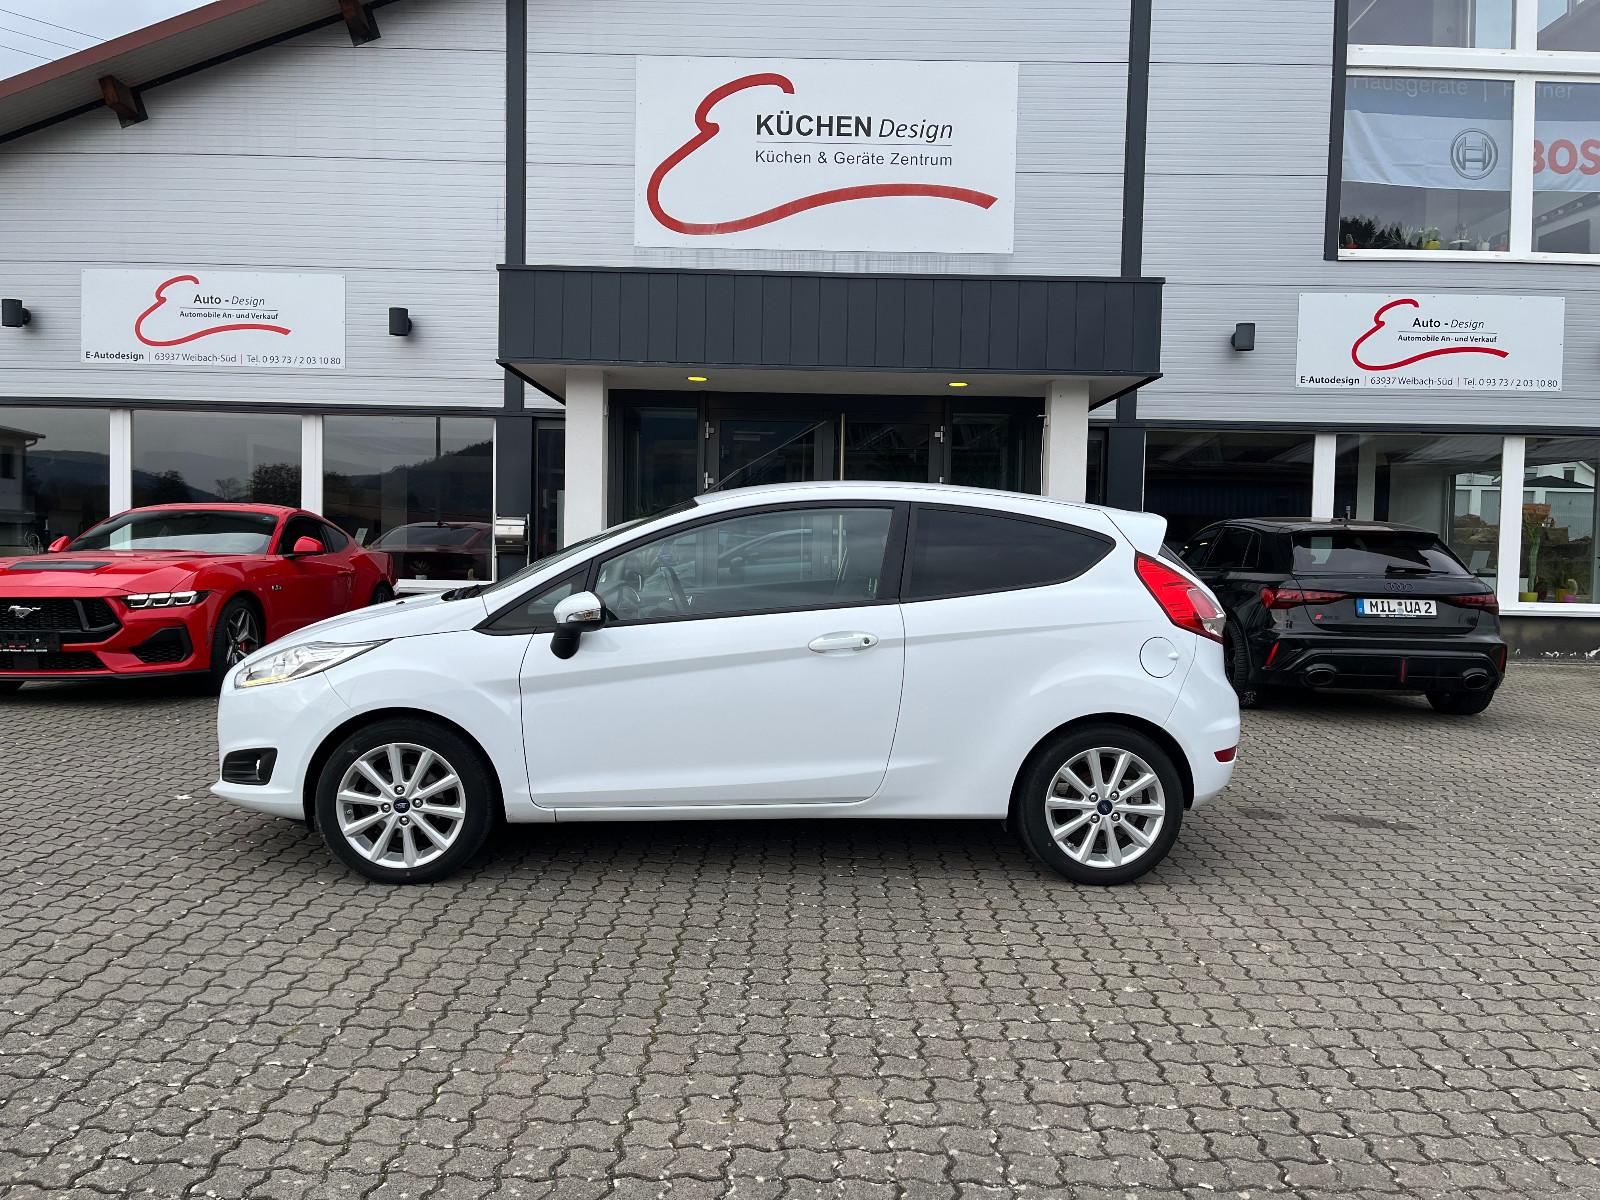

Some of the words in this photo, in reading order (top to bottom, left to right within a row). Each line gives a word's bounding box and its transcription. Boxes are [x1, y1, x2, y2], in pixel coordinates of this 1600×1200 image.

[756, 110, 872, 137] KÜCHEN
[879, 119, 953, 143] Design
[755, 150, 811, 164] Küchen
[817, 151, 828, 164] &
[834, 151, 884, 165] Geräte
[890, 152, 952, 166] Zentrum
[193, 294, 221, 304] Auto
[231, 296, 265, 307] Design
[1412, 317, 1440, 328] Auto
[1450, 319, 1485, 330] Design
[85, 351, 144, 361] E-Autodesign
[154, 352, 180, 361] 63937
[269, 355, 280, 363] 93
[282, 356, 292, 364] 73
[306, 356, 317, 364] 03
[330, 357, 341, 365] 80
[1300, 376, 1360, 386] E-Autodesign
[1370, 376, 1395, 385] 63937
[1486, 378, 1496, 386] 93
[1499, 379, 1509, 387] 73
[1523, 379, 1533, 387] 03
[1547, 379, 1558, 388] 80
[1369, 600, 1396, 613] MIL
[1404, 601, 1422, 614] UA
[1424, 601, 1433, 614] 2
